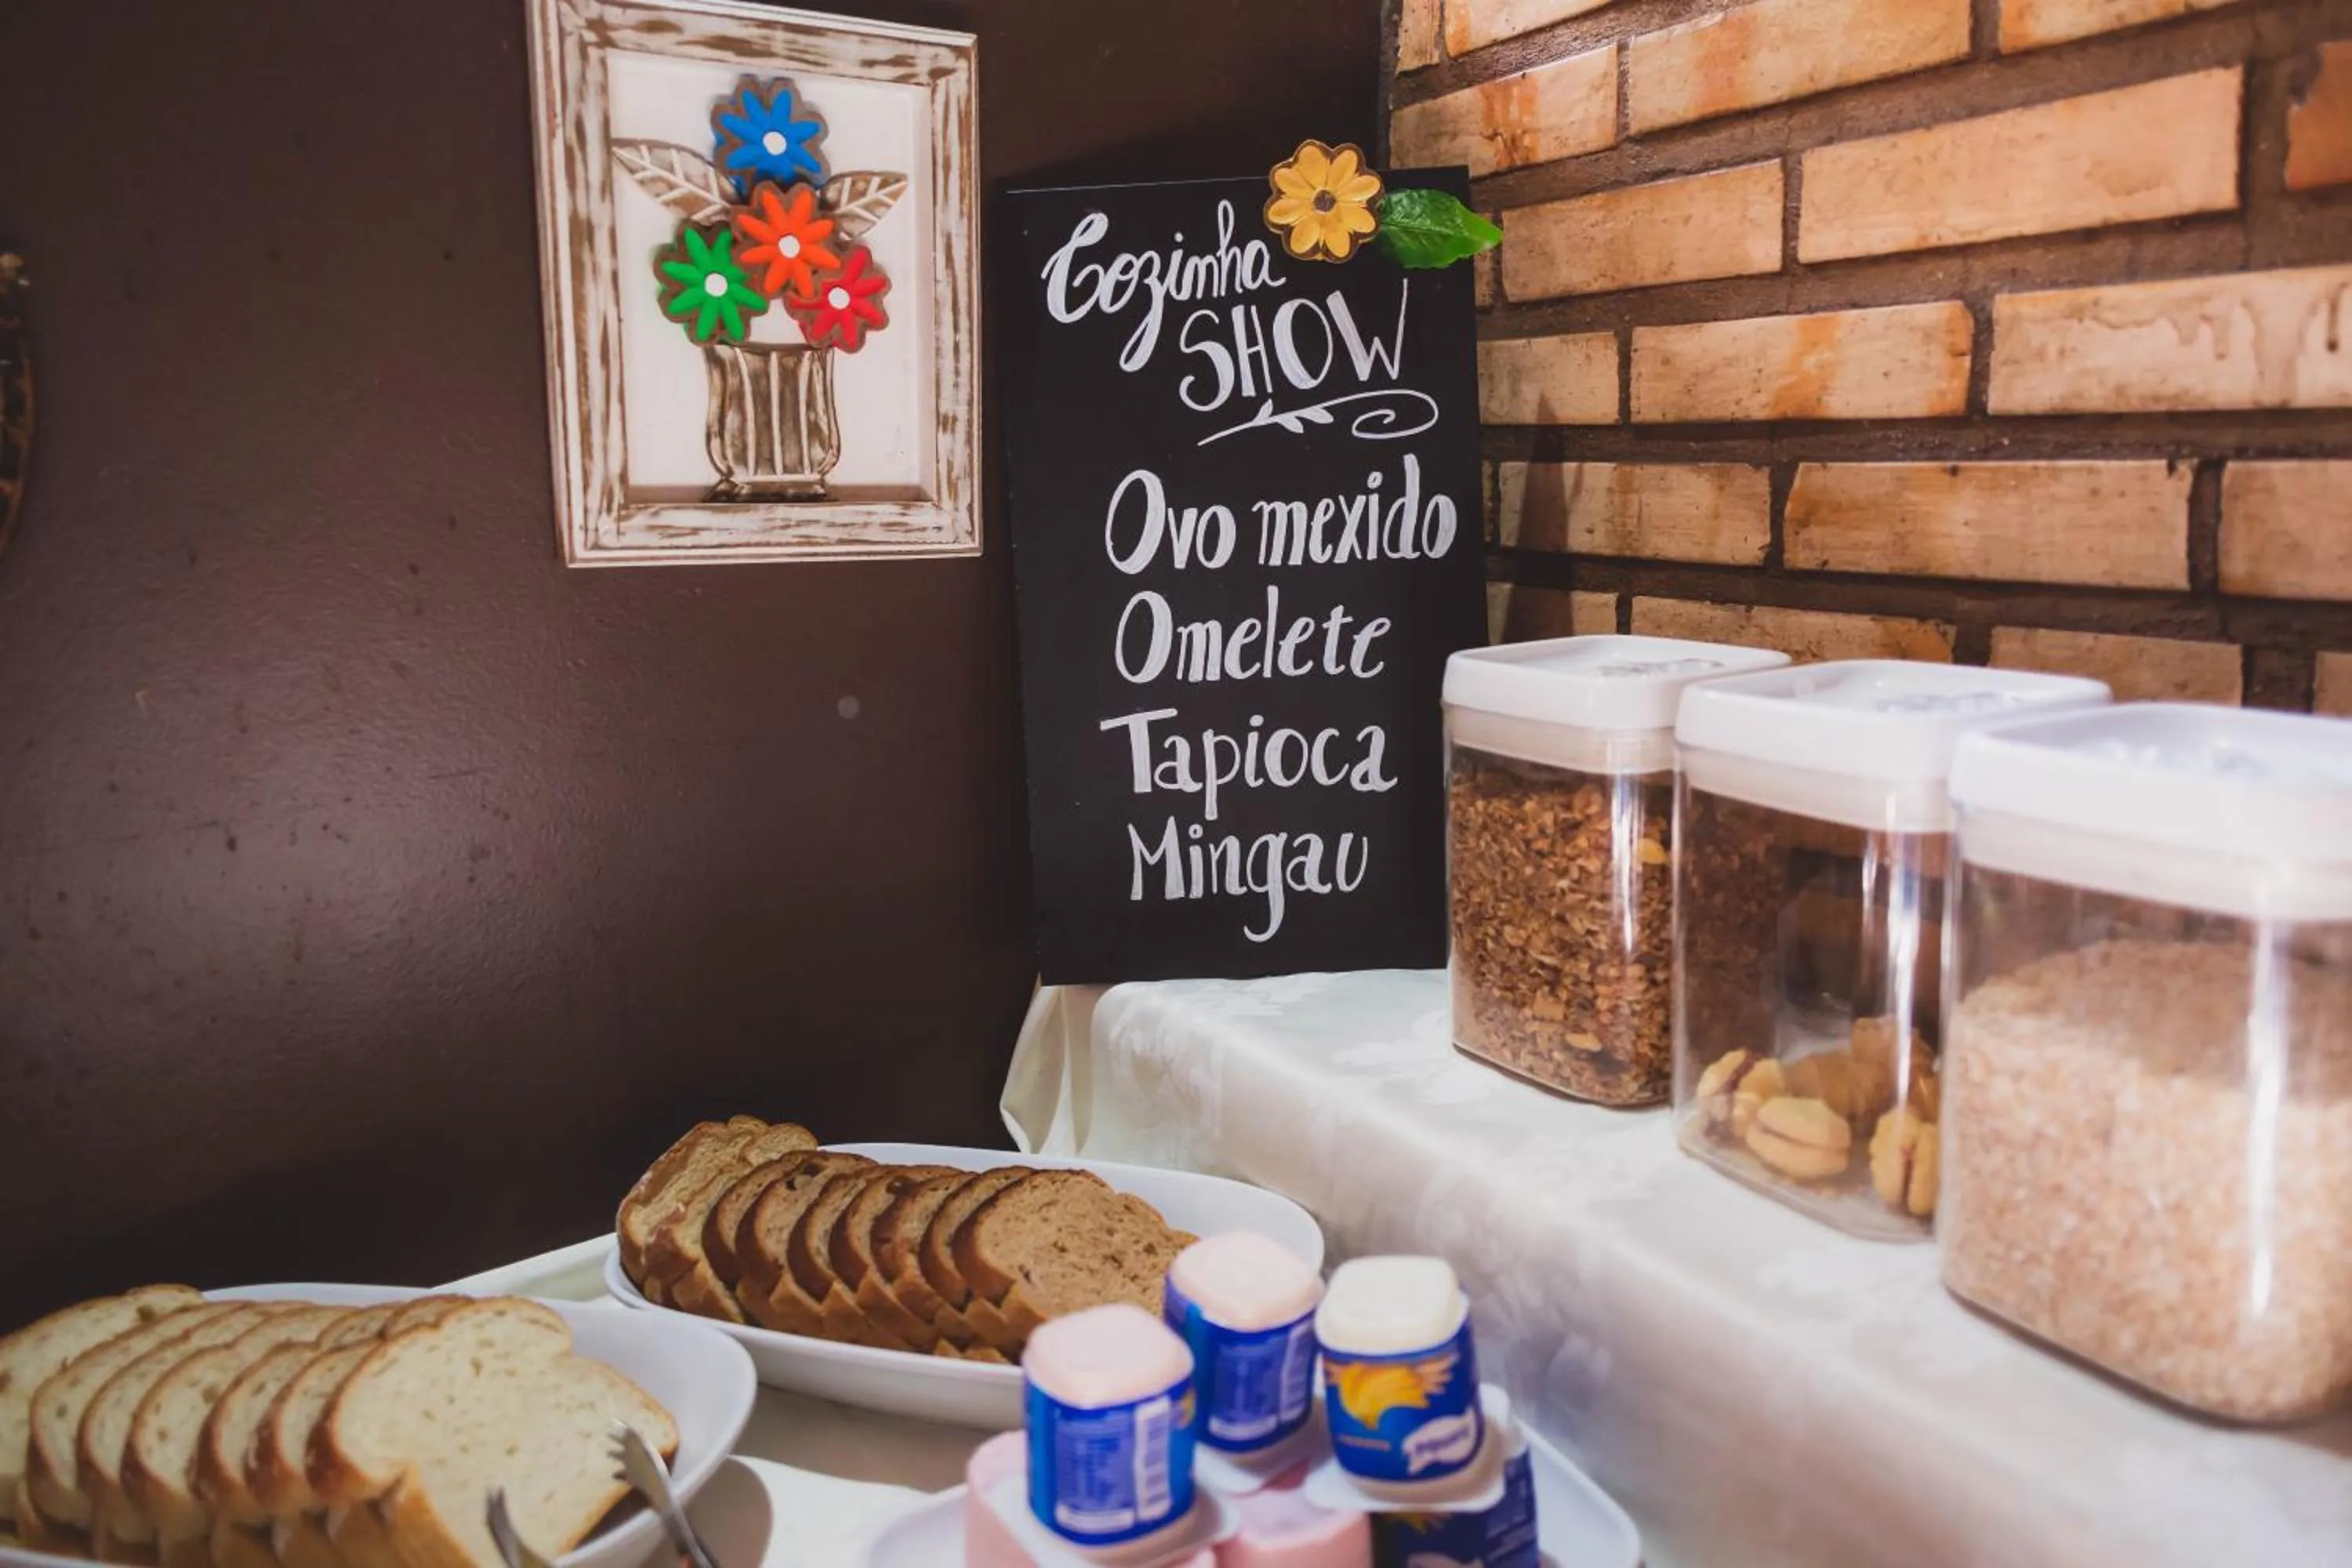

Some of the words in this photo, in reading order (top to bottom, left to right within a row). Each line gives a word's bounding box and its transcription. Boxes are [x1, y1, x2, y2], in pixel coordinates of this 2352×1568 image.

[1041, 199, 1287, 372] Cozinha
[1179, 278, 1408, 412] SHOW
[1105, 470, 1236, 574] Ovo
[1252, 453, 1457, 566] mexido
[1116, 585, 1392, 683] Omelete
[1100, 708, 1398, 820] Tapioca
[1127, 815, 1368, 942] Mingau
